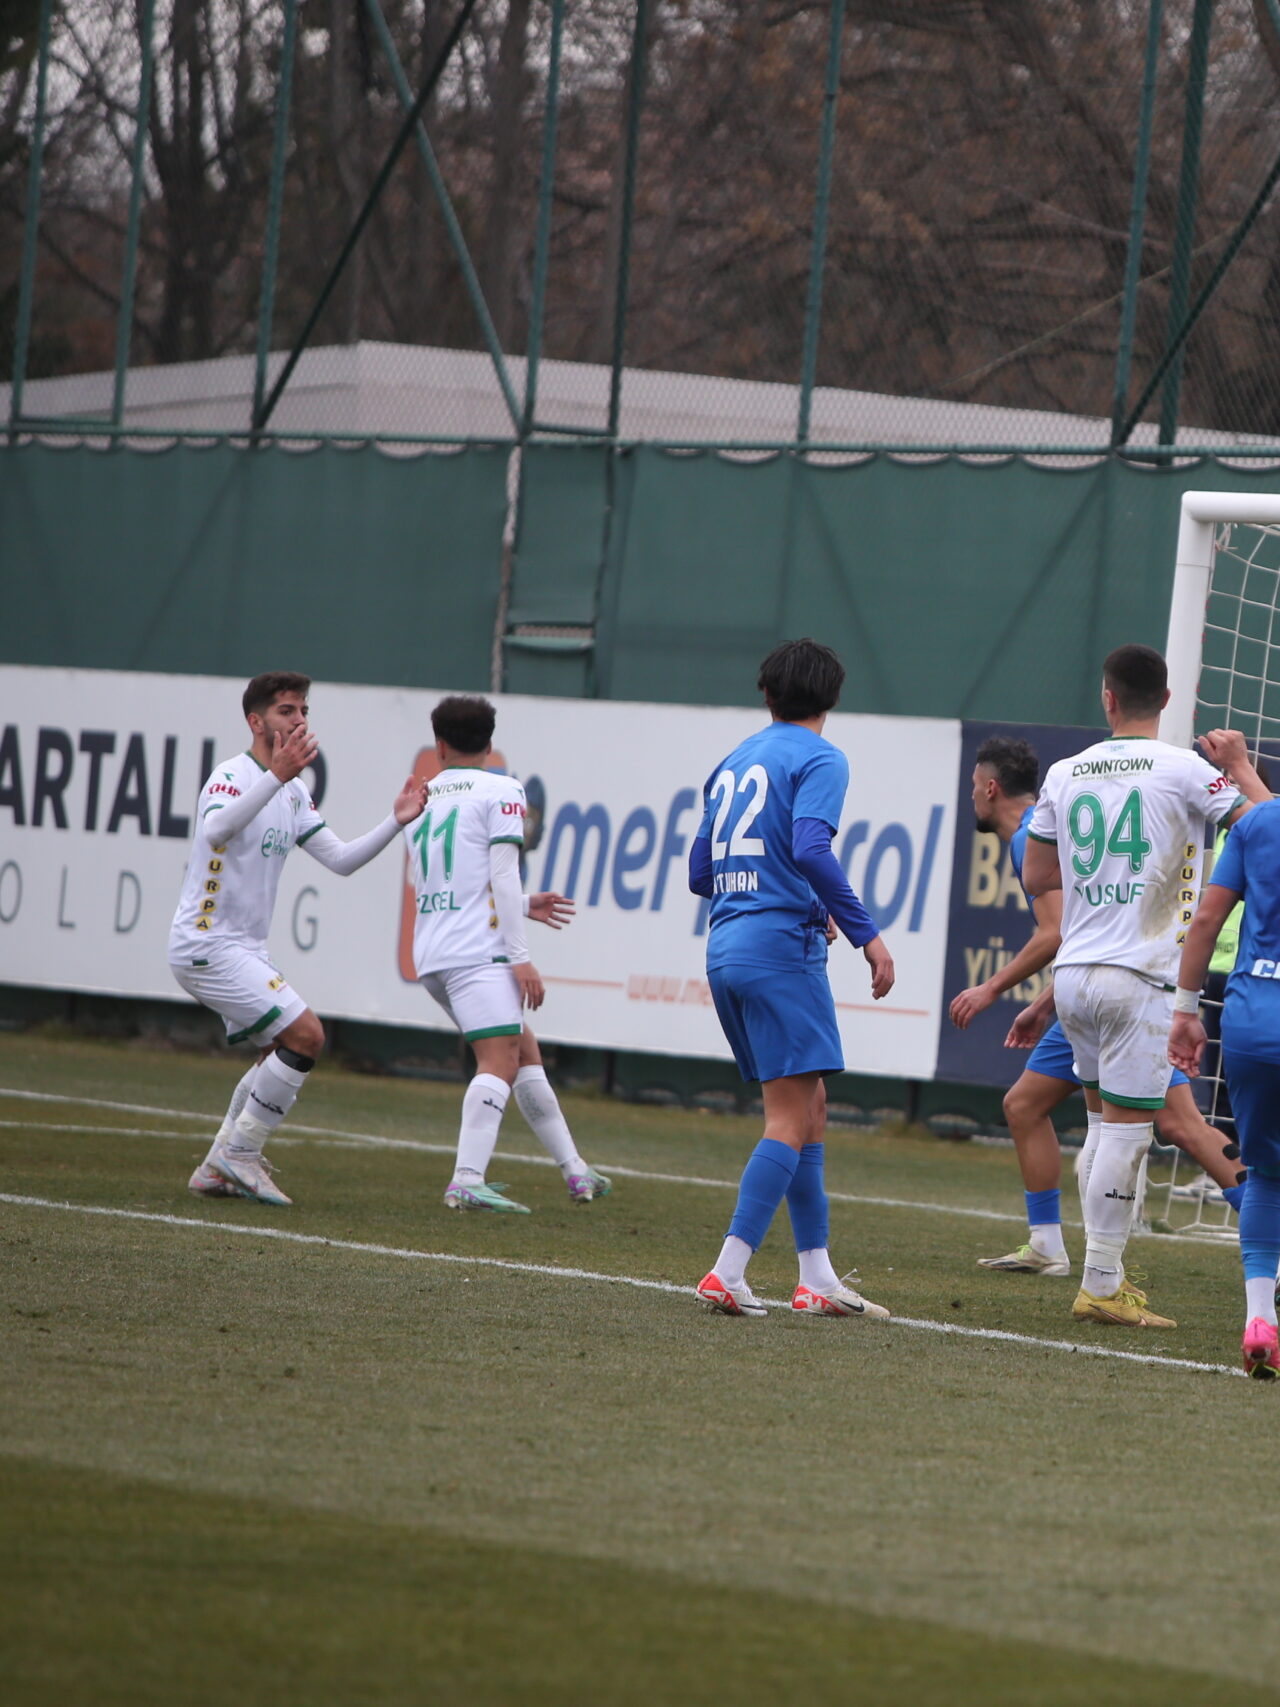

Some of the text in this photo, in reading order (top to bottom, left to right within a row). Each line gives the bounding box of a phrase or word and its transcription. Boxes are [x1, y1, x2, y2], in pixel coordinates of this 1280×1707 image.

[1072, 758, 1154, 777] DOWNTOWN
[412, 804, 460, 884] 11
[710, 764, 769, 862] 22
[1067, 785, 1153, 879] 94
